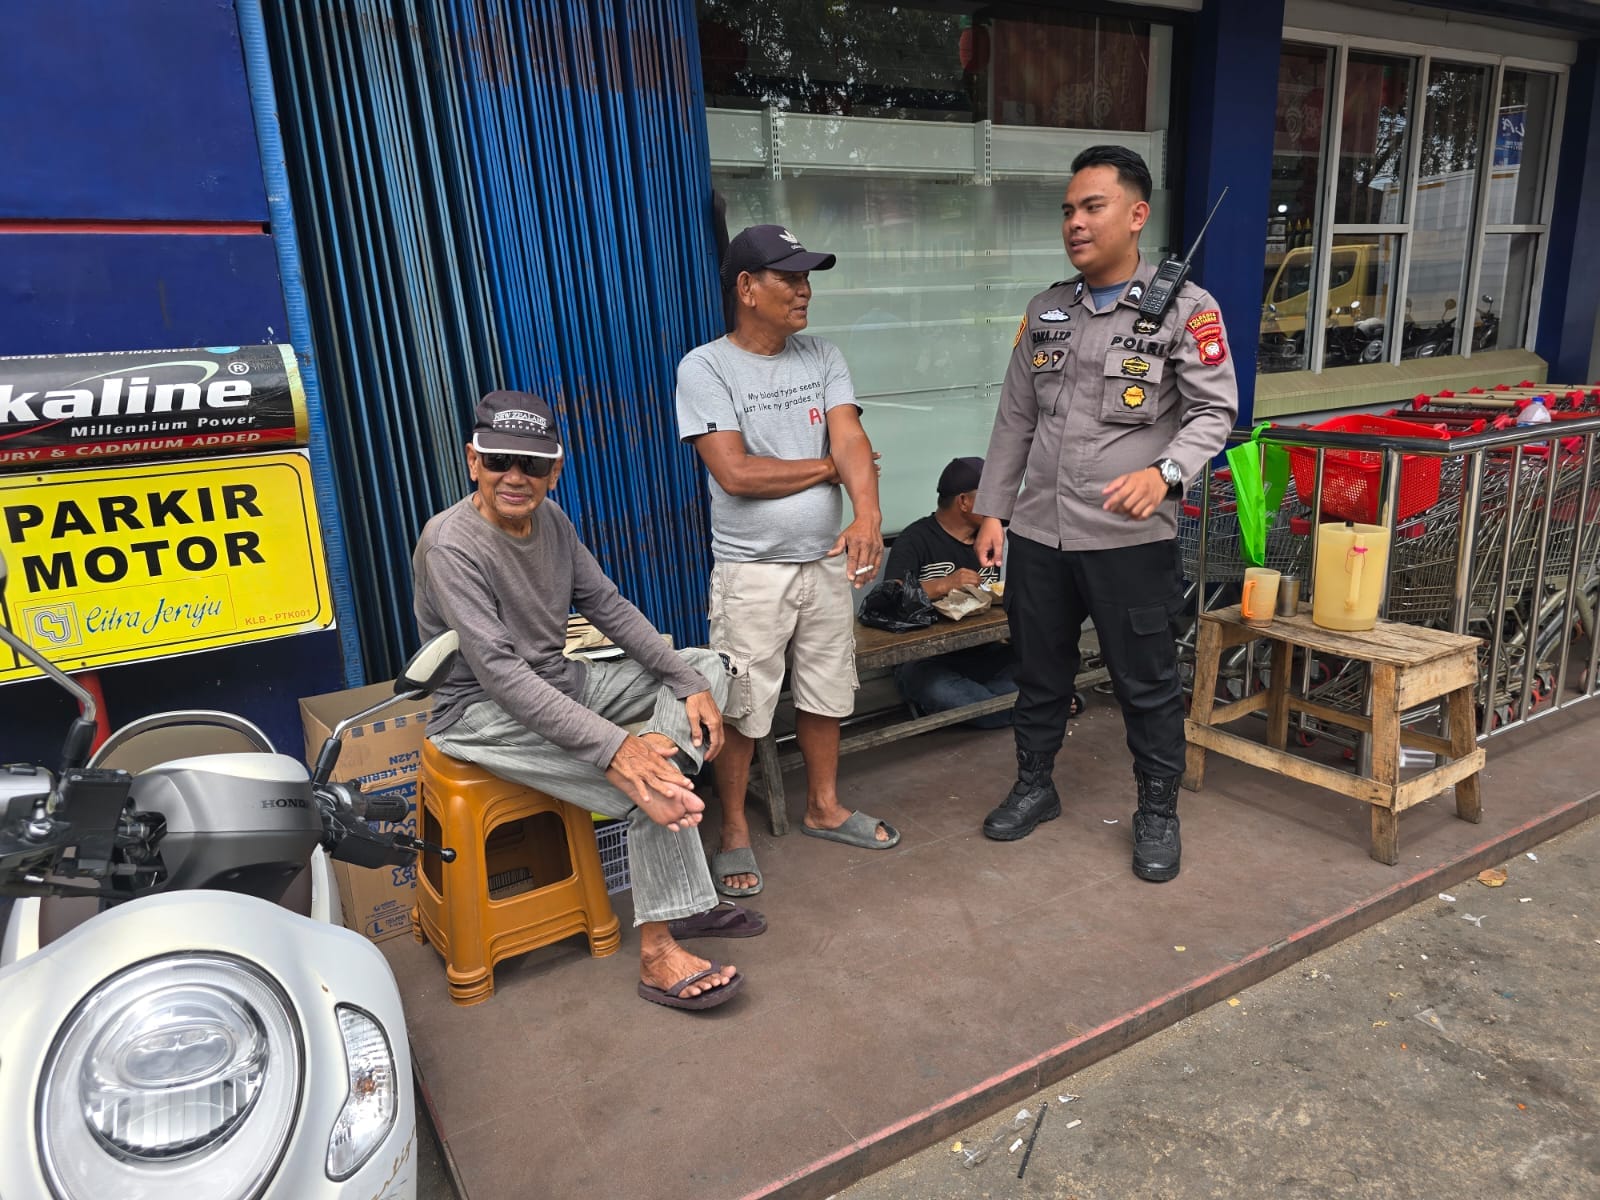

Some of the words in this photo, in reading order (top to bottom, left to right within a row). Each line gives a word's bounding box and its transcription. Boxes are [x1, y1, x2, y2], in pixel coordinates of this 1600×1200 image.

[1111, 336, 1166, 355] POLRI
[0, 376, 252, 423] kaline
[748, 392, 759, 402] My
[760, 389, 779, 400] blood
[780, 387, 797, 398] type
[758, 402, 772, 411] like
[808, 407, 822, 425] A
[71, 419, 187, 438] Millennium
[197, 414, 256, 428] Power
[50, 448, 66, 458] &
[76, 438, 184, 456] CADMIUM
[191, 432, 261, 446] ADDED
[3, 483, 264, 543] PARKIR
[22, 530, 266, 593] MOTOR
[245, 615, 266, 625] KLB
[274, 608, 311, 621] PTK001
[389, 749, 419, 765] L42N
